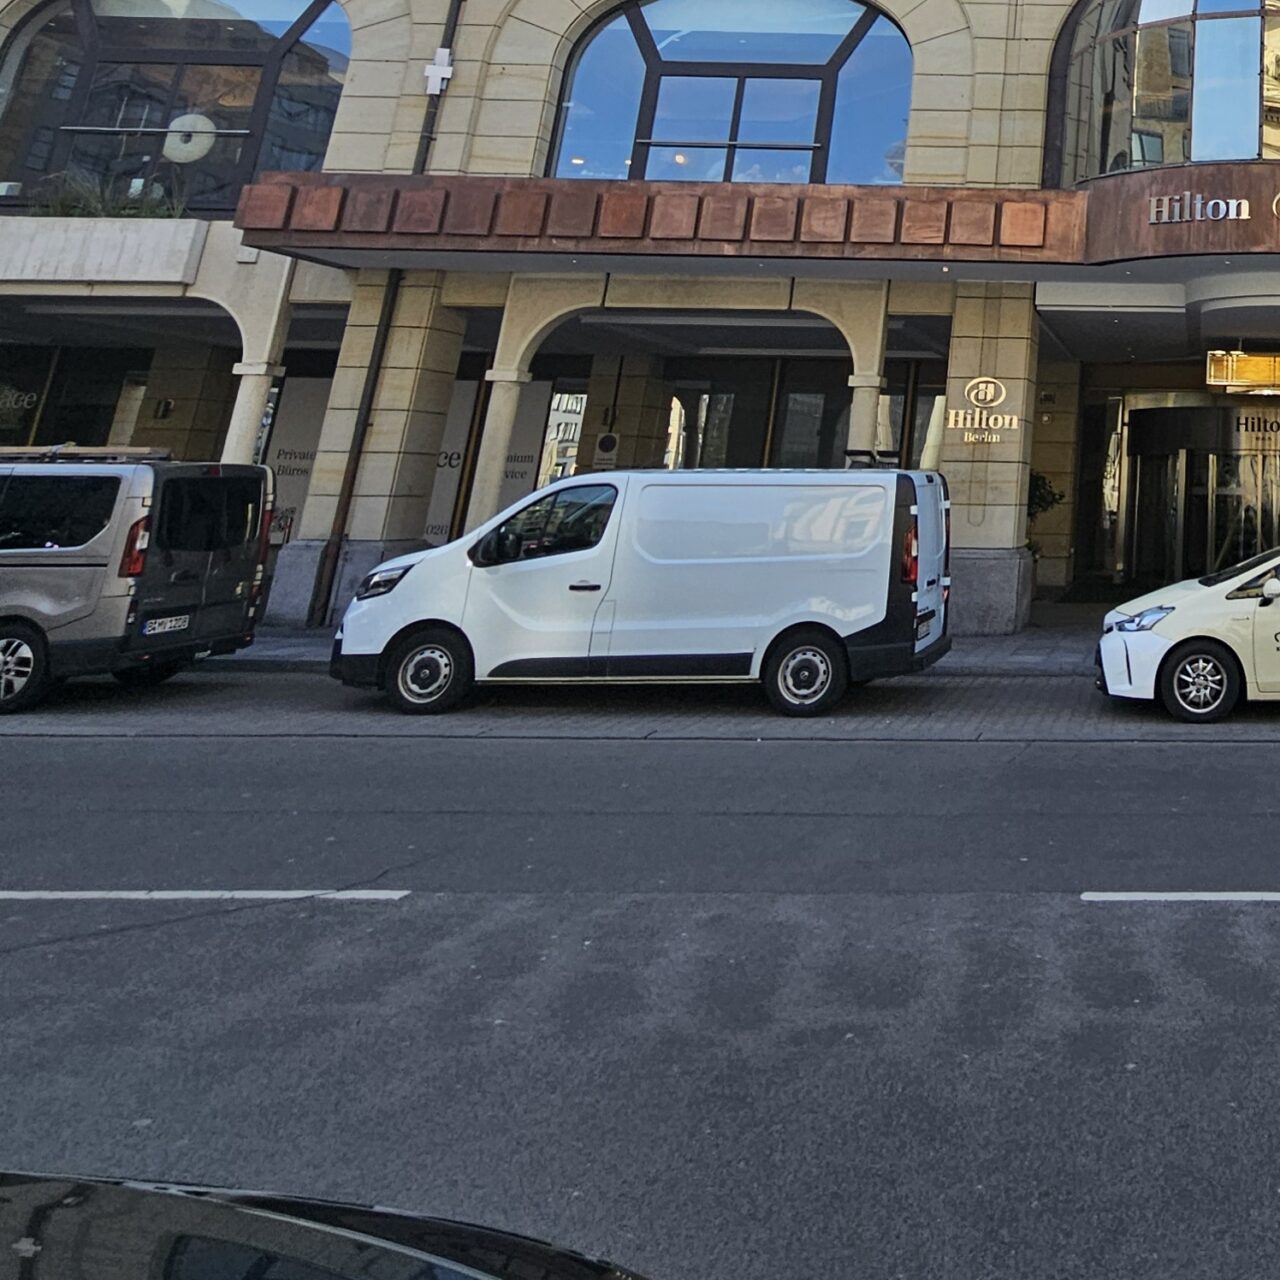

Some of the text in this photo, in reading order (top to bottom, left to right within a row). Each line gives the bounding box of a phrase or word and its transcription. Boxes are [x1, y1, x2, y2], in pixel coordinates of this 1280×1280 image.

[1149, 191, 1251, 224] Hilton
[947, 407, 1019, 429] Hilton
[963, 431, 1001, 443] Berlin
[277, 448, 315, 461] Private
[276, 464, 309, 476] Büros
